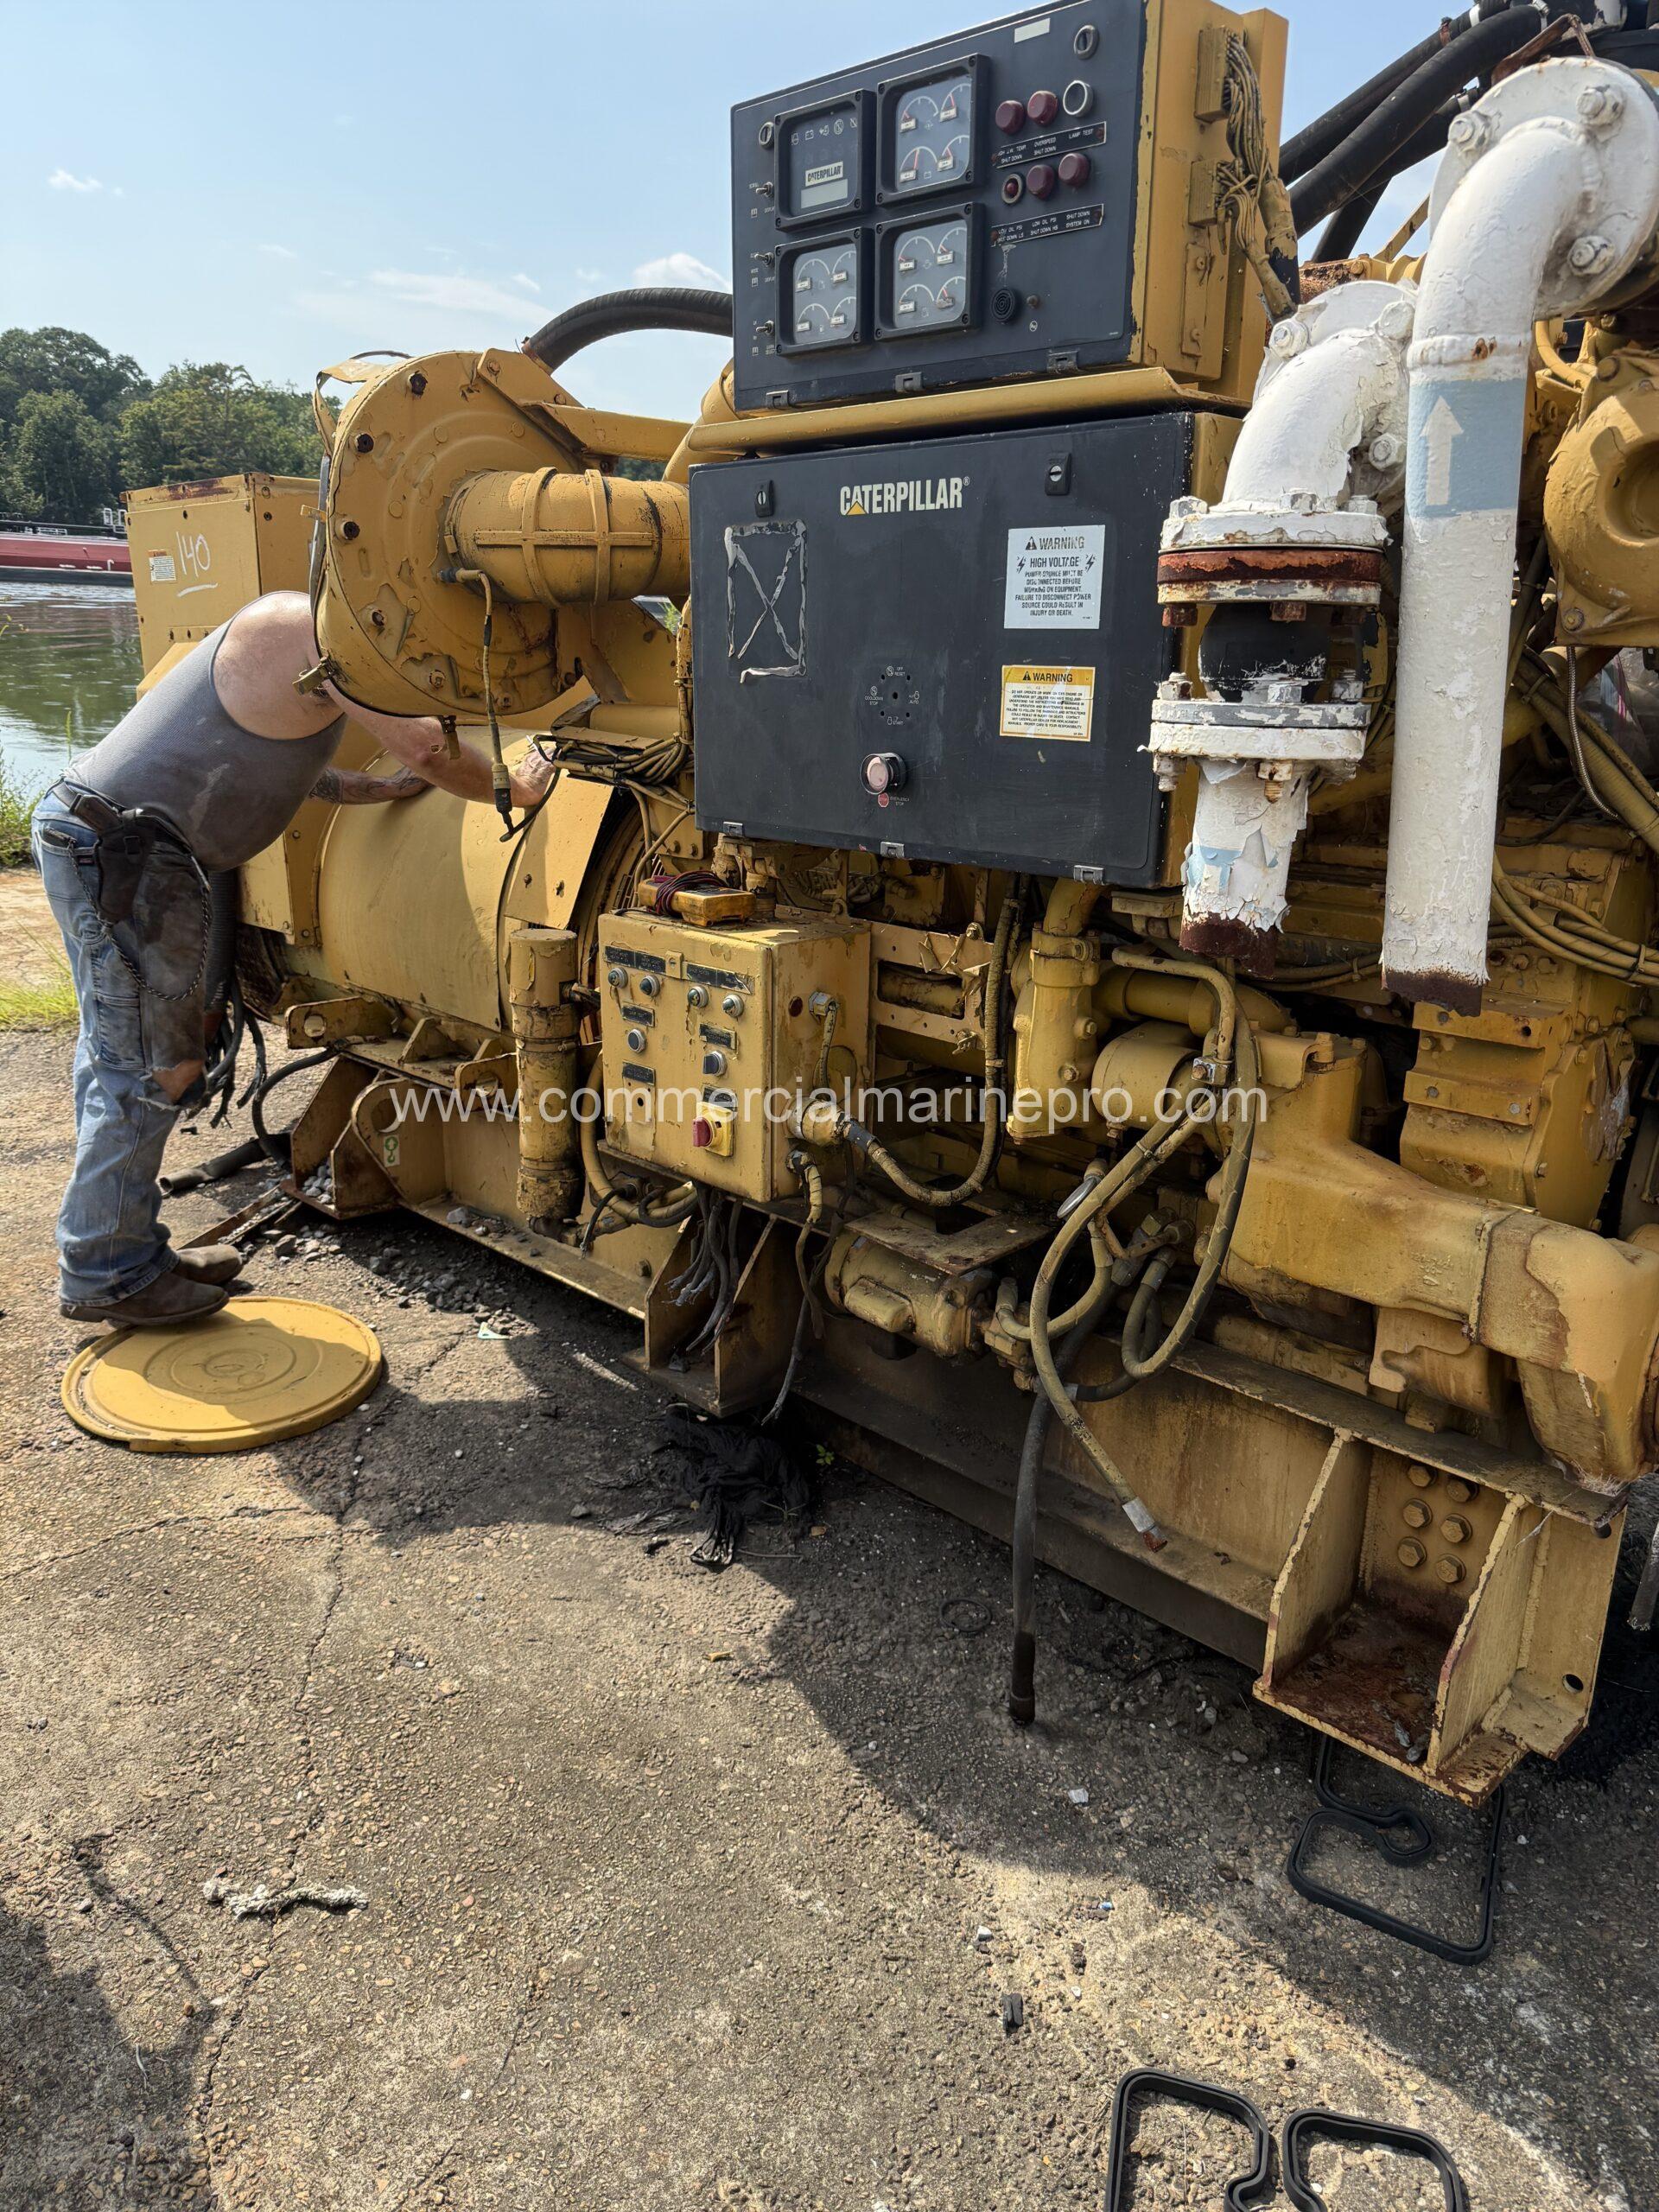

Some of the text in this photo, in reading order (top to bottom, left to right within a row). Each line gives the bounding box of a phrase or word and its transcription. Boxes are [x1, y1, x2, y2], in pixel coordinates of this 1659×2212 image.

[1039, 536, 1085, 550] WARNING
[176, 531, 211, 577] 140
[1030, 556, 1079, 568] HIGH VOLTAGE
[1033, 673, 1073, 682] WARNING
